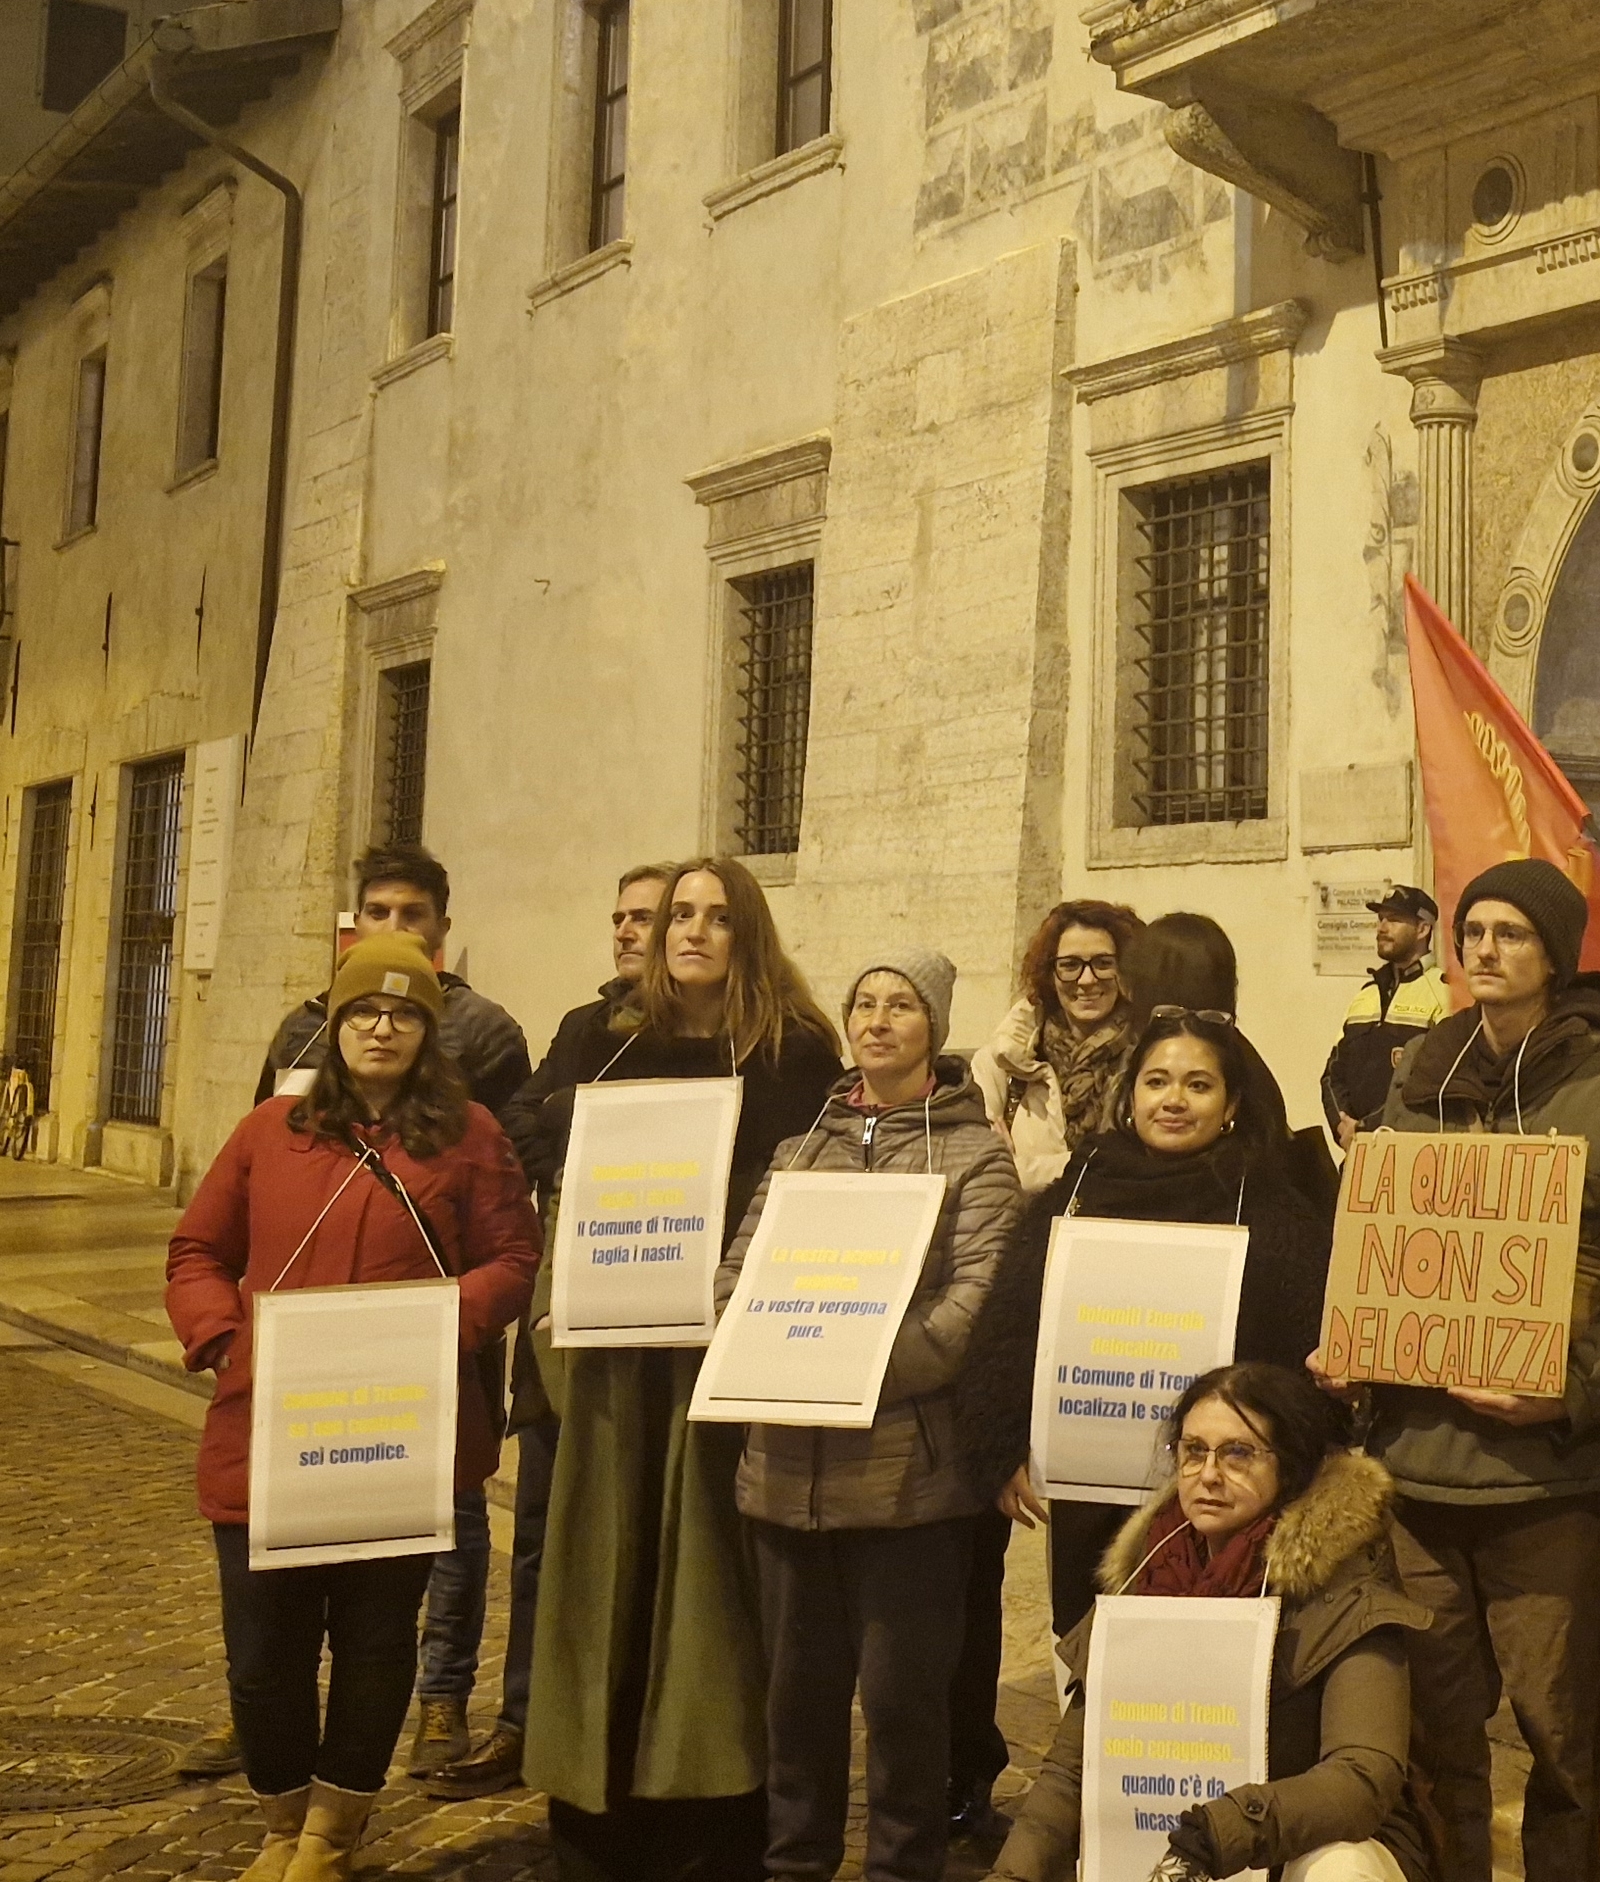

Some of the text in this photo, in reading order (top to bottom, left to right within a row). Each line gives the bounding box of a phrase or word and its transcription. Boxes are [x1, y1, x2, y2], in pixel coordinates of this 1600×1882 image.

[1350, 920, 1377, 929] Comuna
[1347, 1143, 1396, 1214] LA
[589, 1220, 642, 1237] Comune
[646, 1216, 659, 1234] di
[663, 1215, 705, 1233] Trento
[592, 1243, 685, 1266] taglia i nastri.
[1357, 1224, 1547, 1307] NON SI
[746, 1298, 888, 1316] La vostra vergogna
[1076, 1302, 1205, 1332] Dolomiti Energia
[786, 1325, 825, 1340] pure.
[1090, 1336, 1182, 1361] delocalizza.
[1326, 1306, 1564, 1392] DELOCALIZZA
[1058, 1365, 1199, 1391] Il Comune di Tren
[1058, 1396, 1126, 1418] localizza
[1131, 1401, 1145, 1419] le
[299, 1442, 409, 1466] sei complice.
[1109, 1697, 1168, 1723] Comune
[1171, 1699, 1185, 1723] di
[1103, 1733, 1144, 1758] socio
[1122, 1774, 1225, 1799] quando c'è da
[1135, 1808, 1182, 1832] incass
